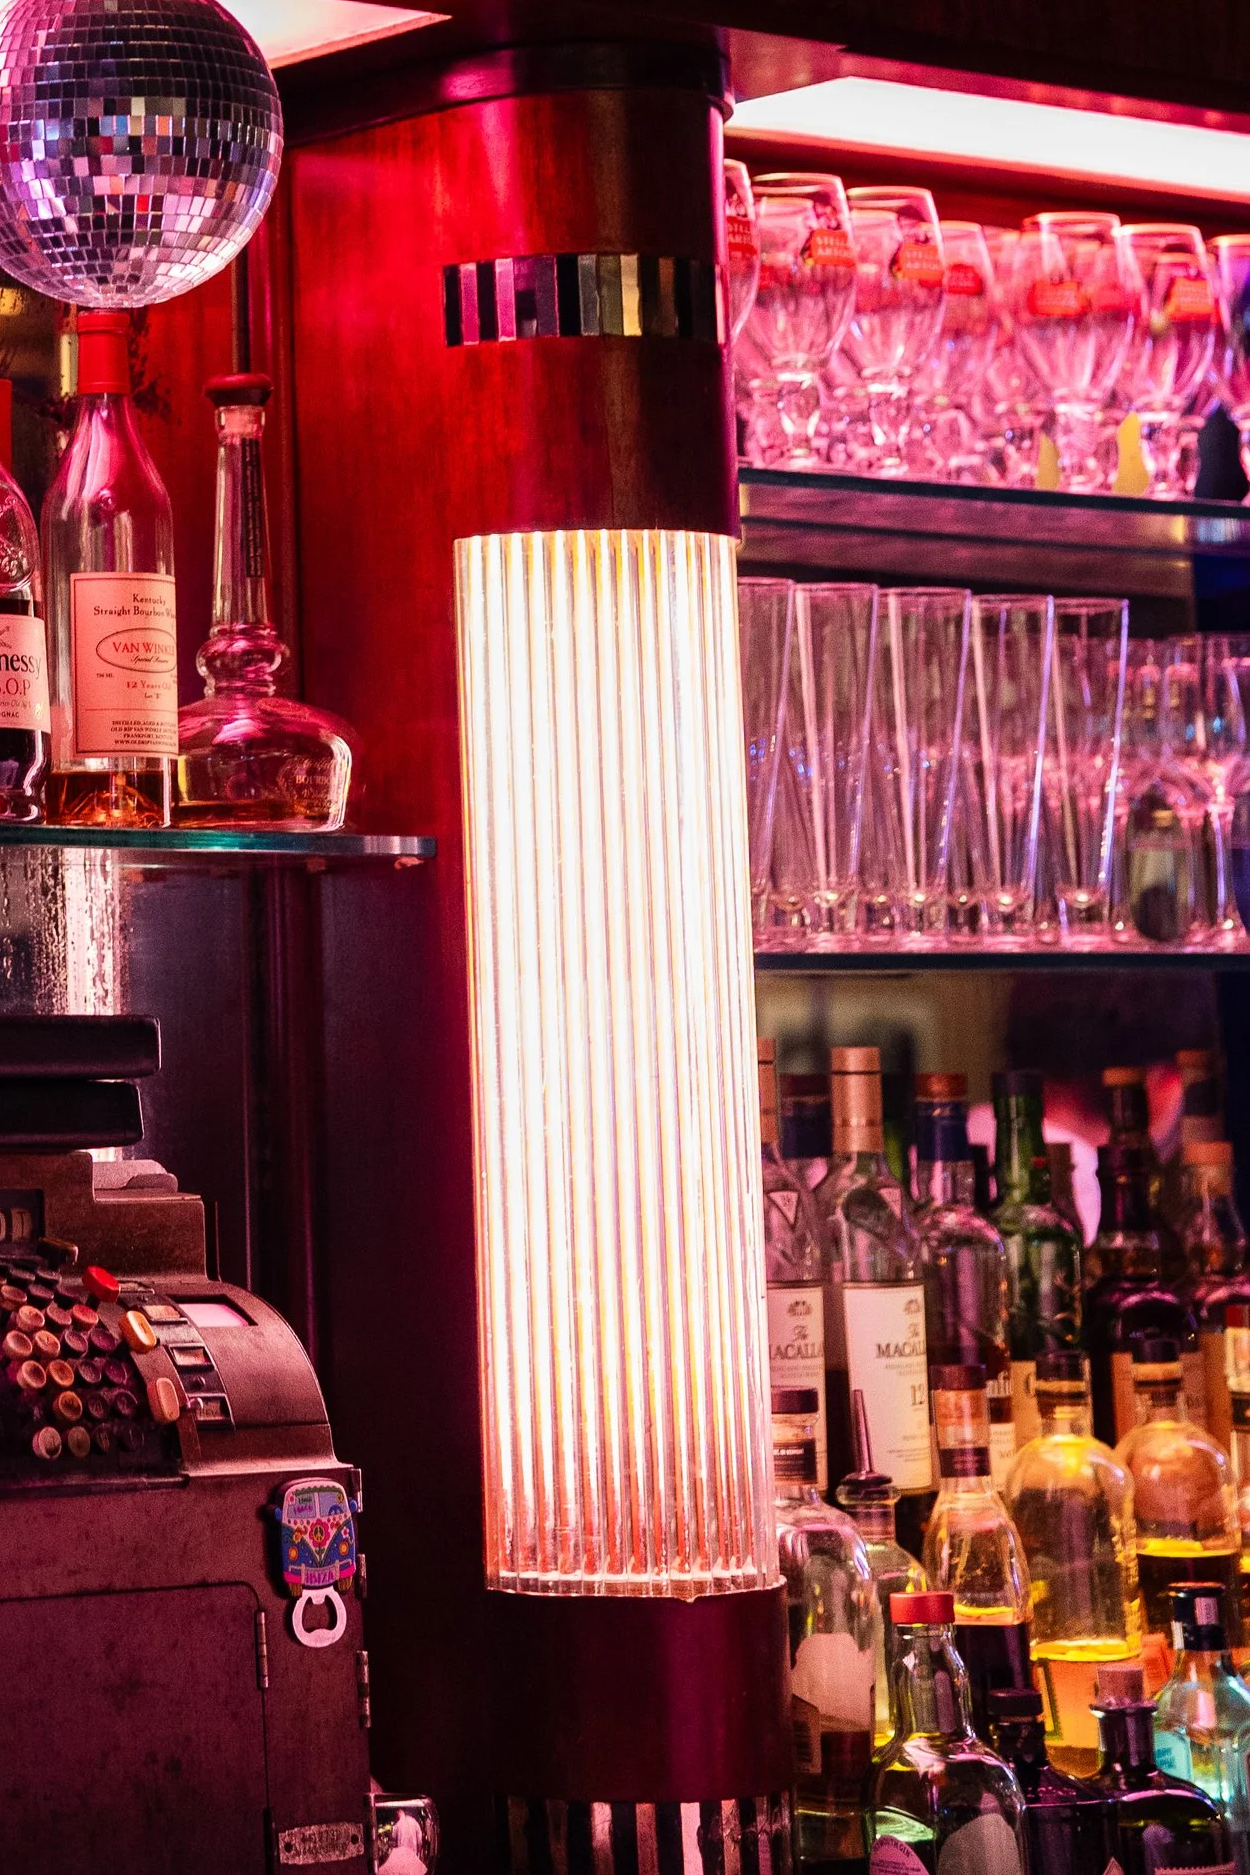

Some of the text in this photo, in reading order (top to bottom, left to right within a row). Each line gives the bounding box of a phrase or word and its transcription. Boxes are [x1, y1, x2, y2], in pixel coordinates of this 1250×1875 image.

[132, 593, 166, 606] Kentucky
[93, 606, 130, 617] Straight
[133, 605, 164, 616] Bourbon
[113, 642, 139, 653] VAN
[127, 681, 137, 689] 12
